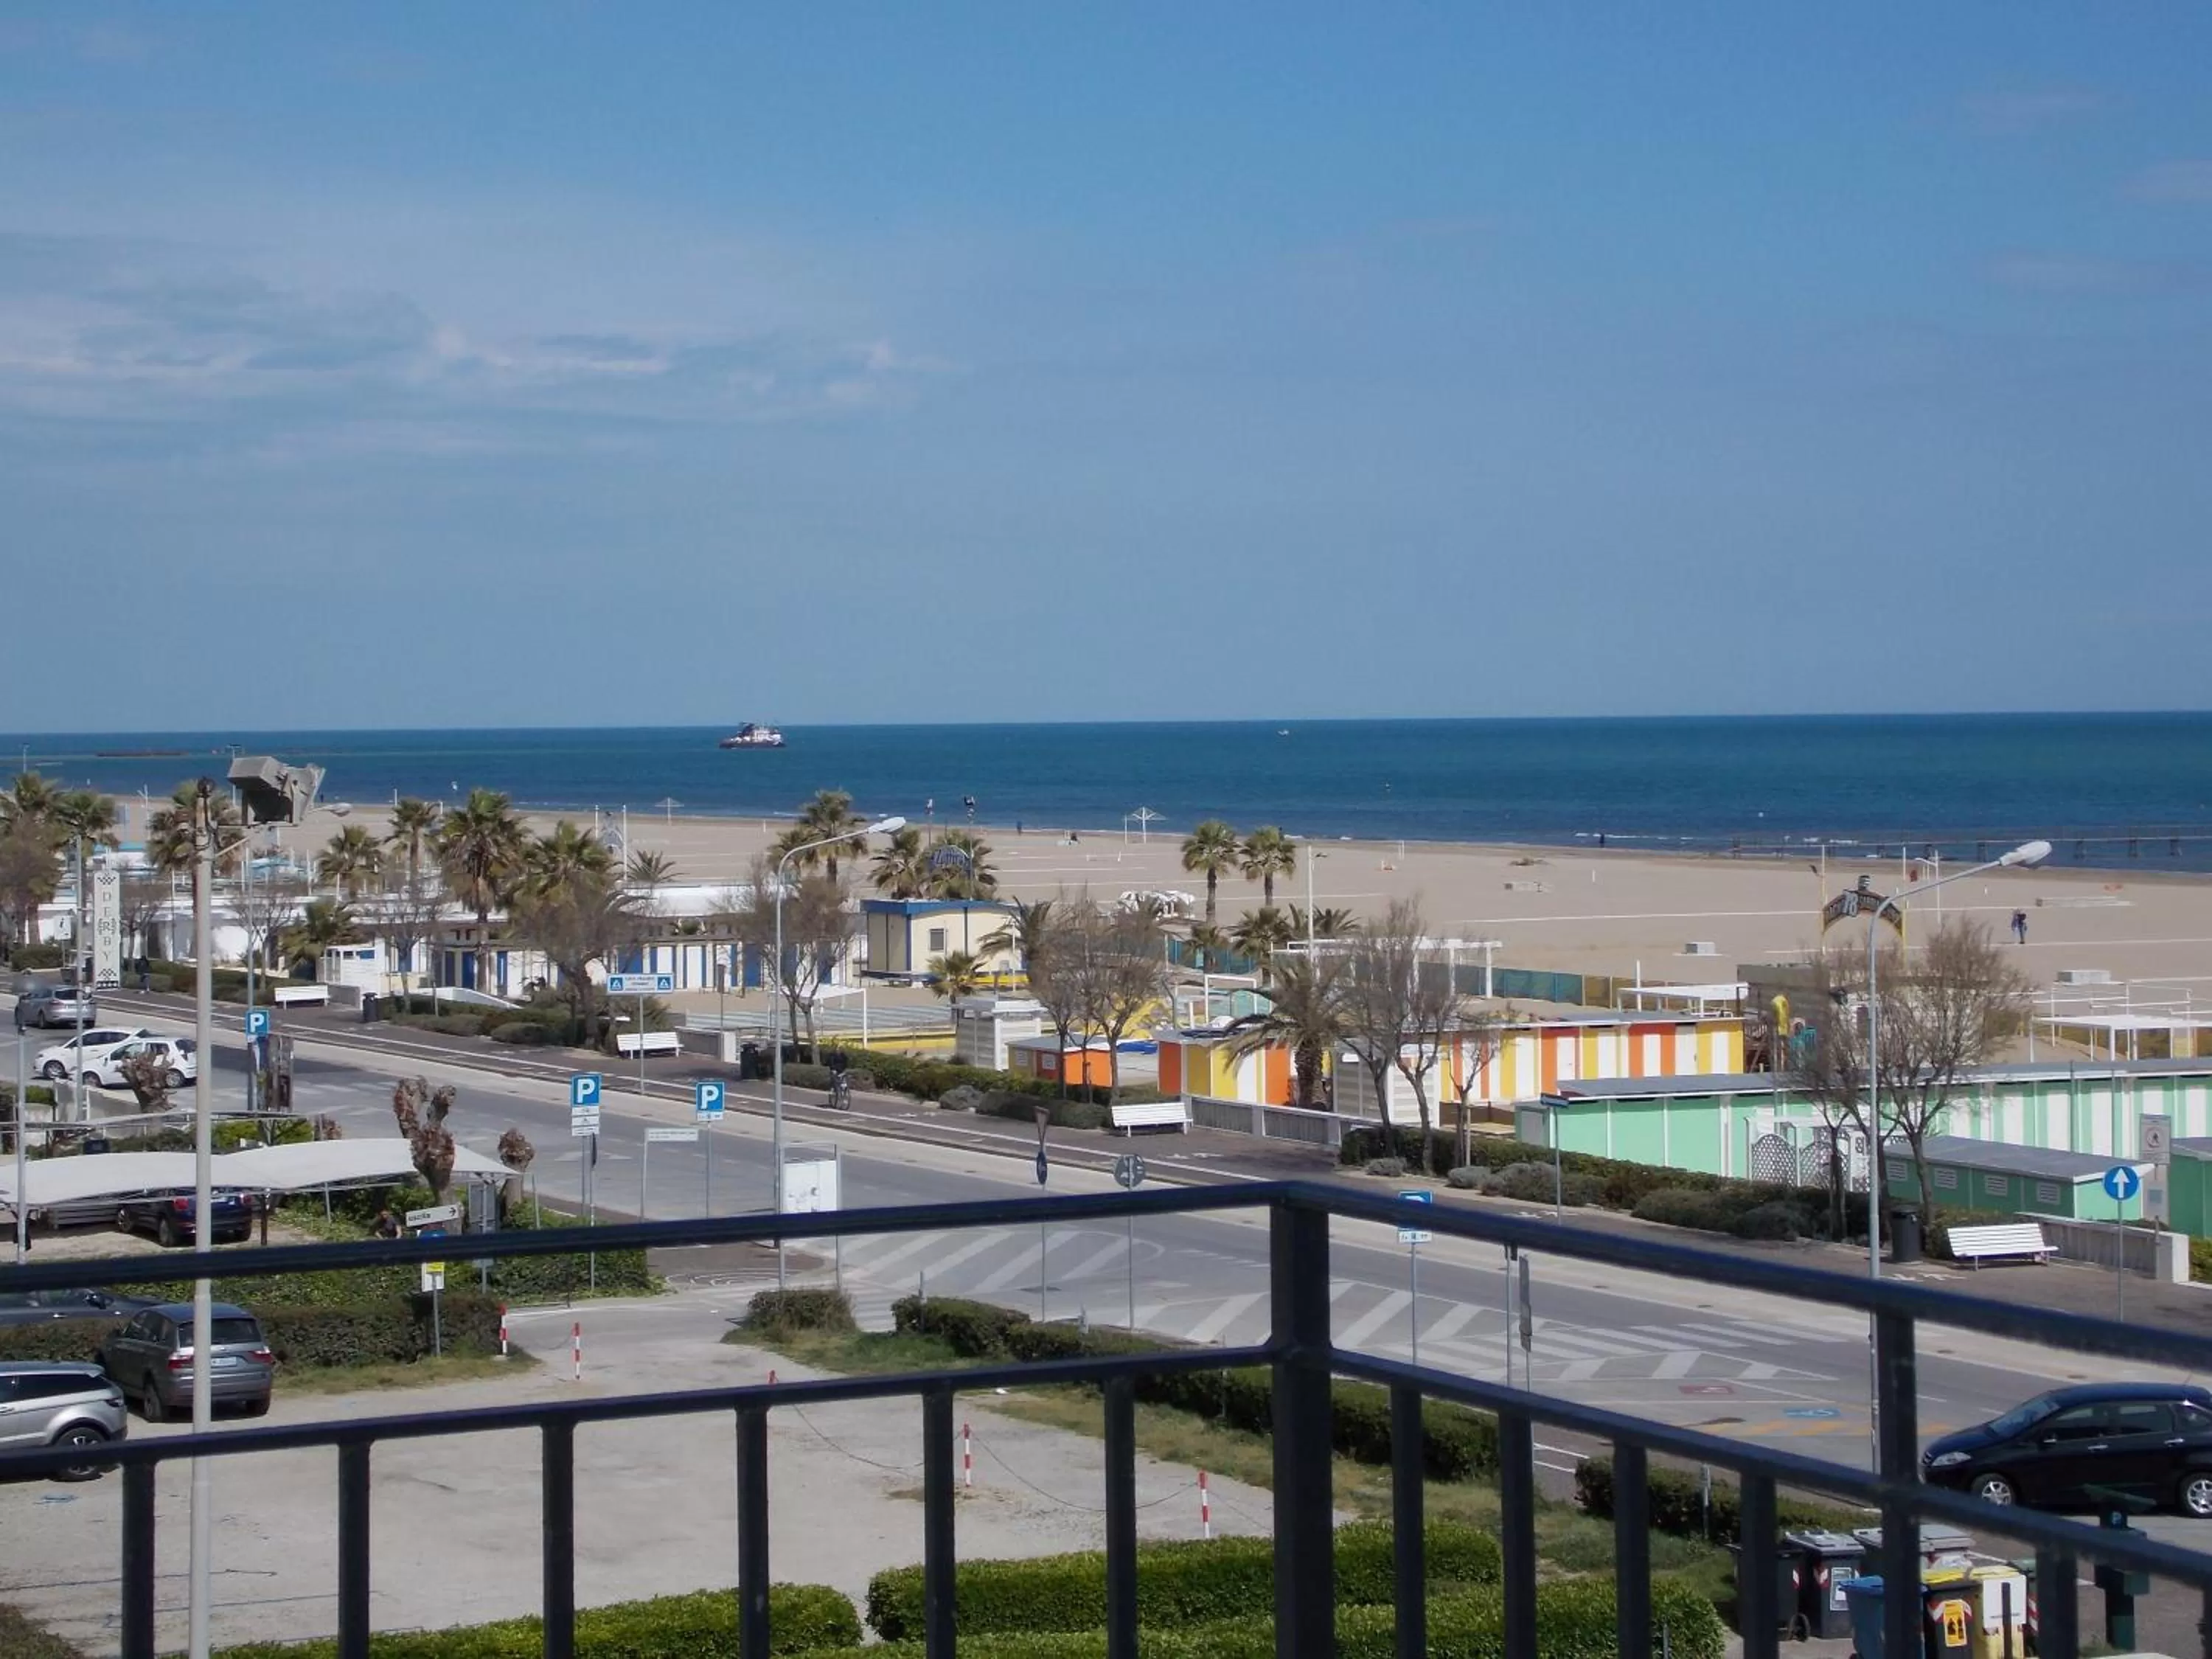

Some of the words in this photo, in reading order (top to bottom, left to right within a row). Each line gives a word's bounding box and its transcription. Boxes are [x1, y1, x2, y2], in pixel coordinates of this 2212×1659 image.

[102, 890, 112, 961] DERBY
[250, 1013, 265, 1033] P
[577, 1079, 595, 1103] P
[700, 1085, 719, 1110] P
